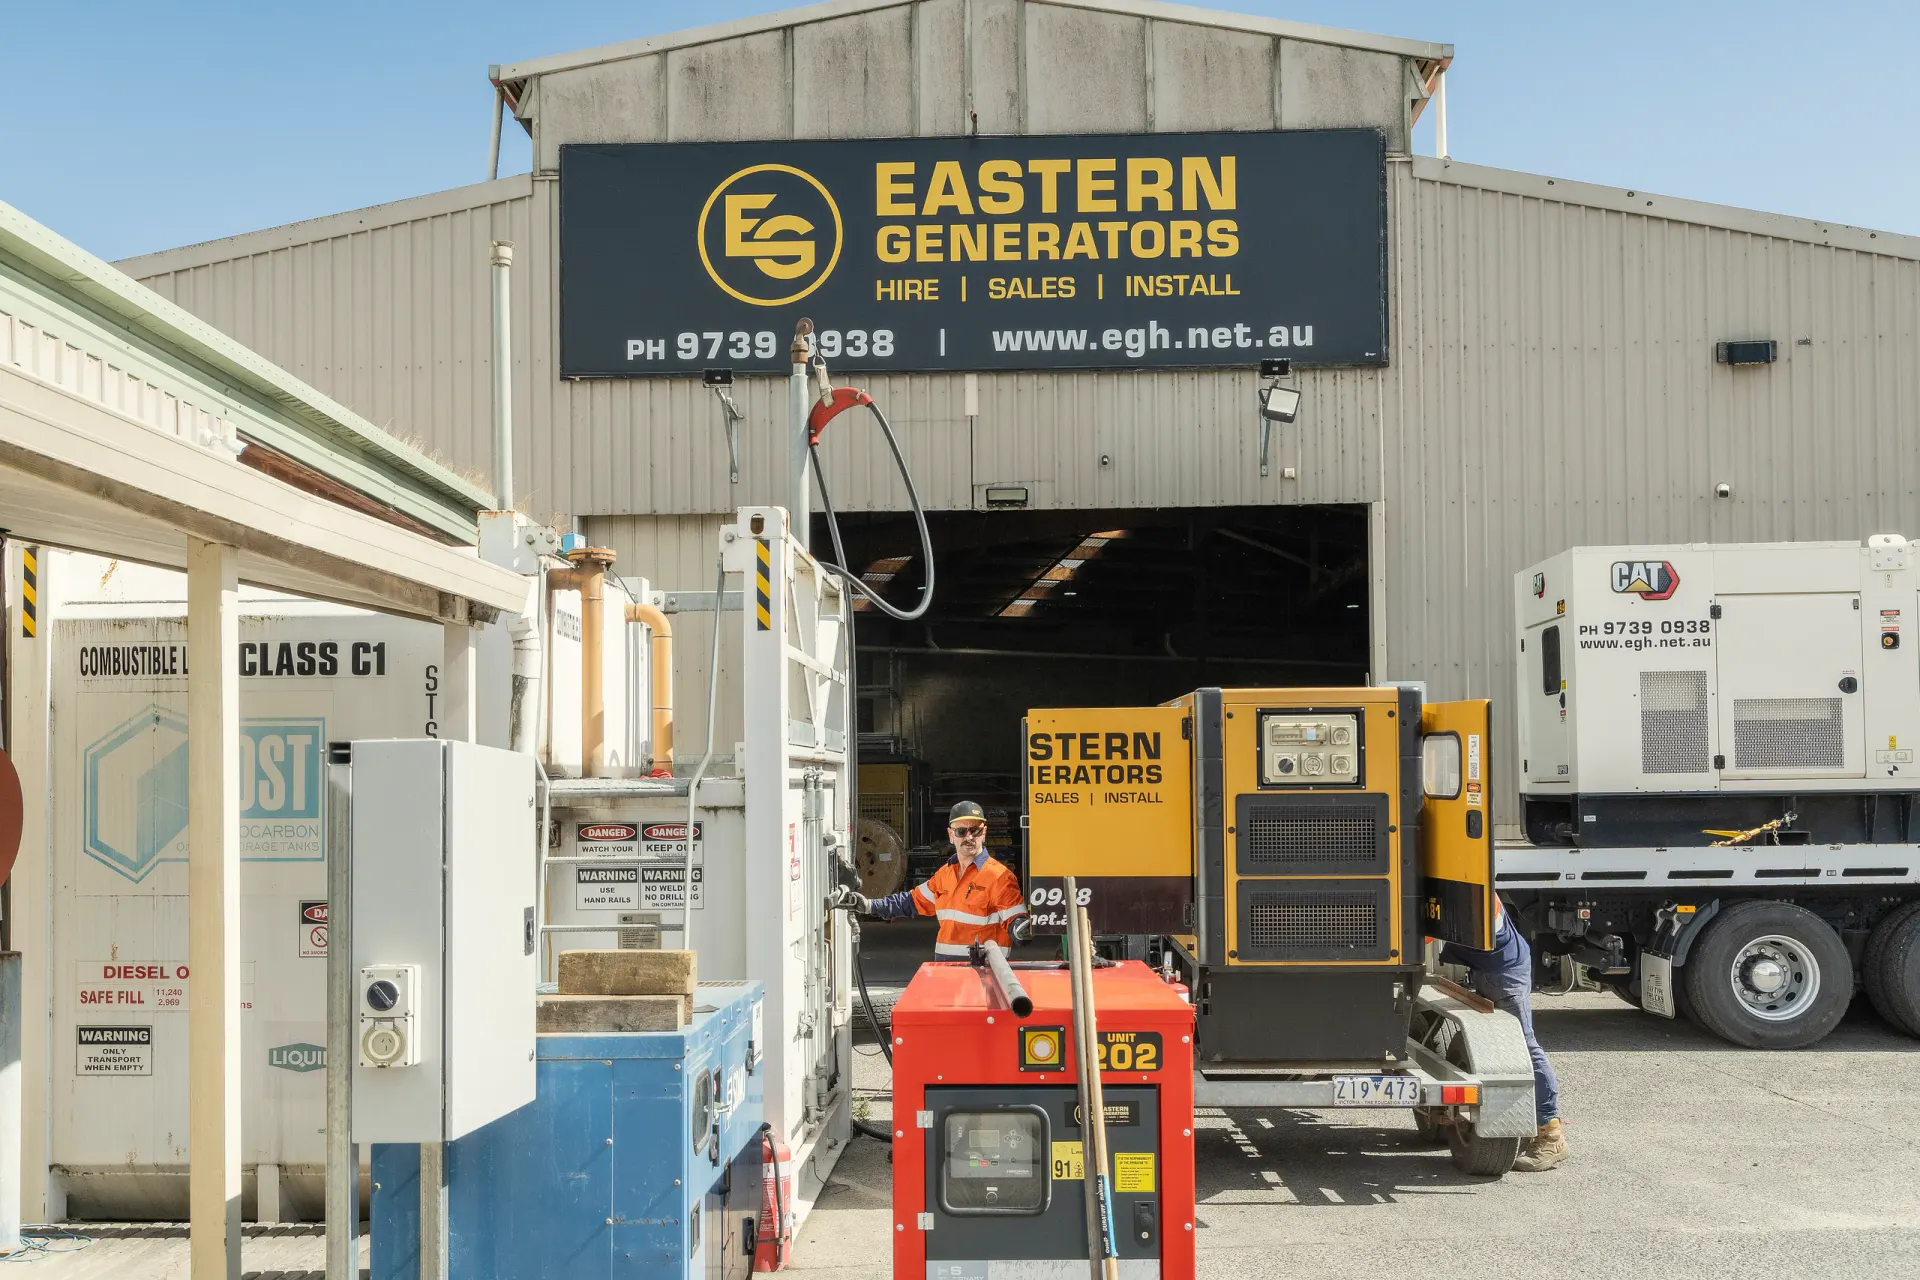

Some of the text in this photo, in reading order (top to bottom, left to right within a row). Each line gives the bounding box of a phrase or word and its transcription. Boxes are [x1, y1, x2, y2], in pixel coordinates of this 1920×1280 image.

[876, 156, 1236, 216] EASTERN
[876, 219, 1240, 263] GENERATORS
[876, 273, 1241, 301] HIRE SALES INSTALL
[626, 339, 665, 360] PH
[676, 331, 777, 359] 9739
[992, 320, 1314, 358] www.egh.net.au
[1612, 562, 1662, 592] CAT
[1579, 620, 1710, 635] PH 9739 0938
[1580, 636, 1711, 651] www.egh.net.au
[80, 646, 178, 676] COMBUSTIBLE
[239, 642, 386, 676] CLASS C1
[1035, 792, 1163, 804] SALES INSTALL
[588, 828, 627, 837] DANGER
[652, 827, 688, 836] DANGE
[646, 844, 673, 852] KEEP
[580, 871, 637, 881] WARNING
[643, 870, 701, 880] WARNIG
[1030, 888, 1092, 906] 098
[103, 966, 169, 979] DIESEL
[80, 990, 145, 1004] SAFE FILL
[156, 989, 183, 997] 11,240
[81, 1030, 149, 1042] WARNING
[1107, 1033, 1136, 1043] UNIT
[1384, 1081, 1417, 1100] 473
[1055, 1160, 1070, 1178] 91
